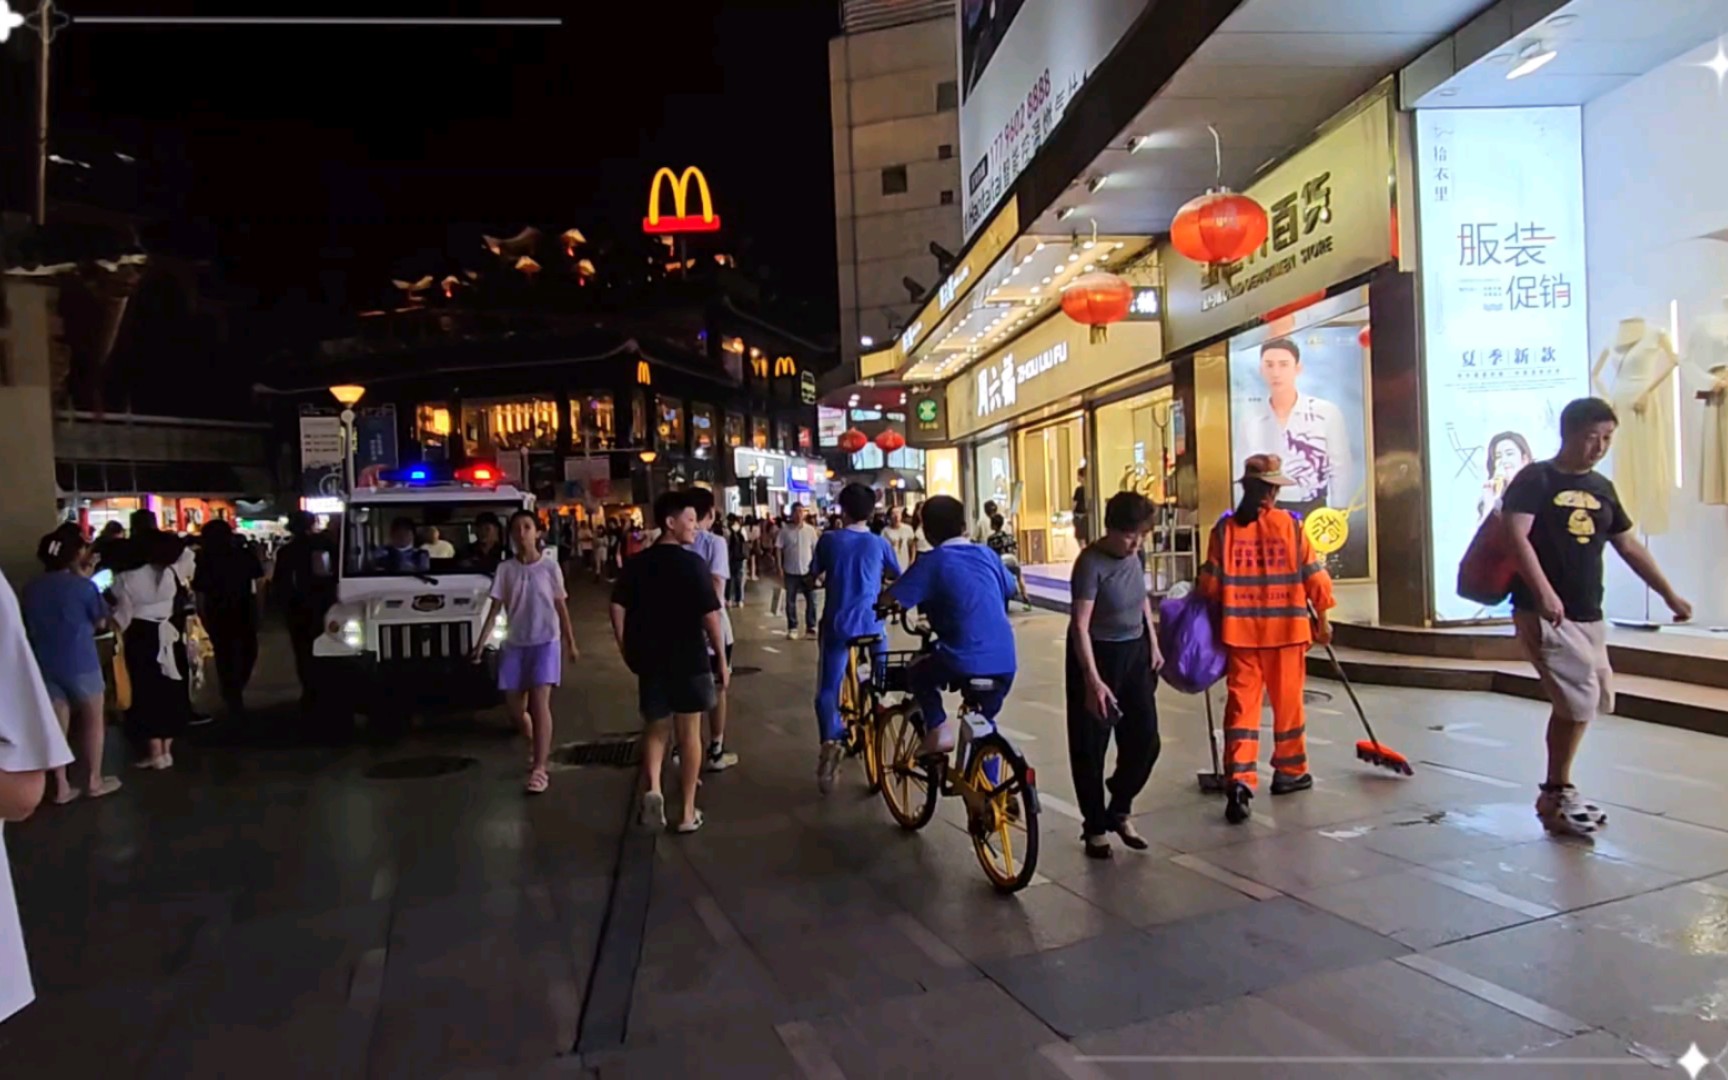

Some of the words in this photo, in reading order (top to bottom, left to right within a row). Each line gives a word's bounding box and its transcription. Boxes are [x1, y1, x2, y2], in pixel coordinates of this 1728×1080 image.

[1300, 235, 1334, 264] STORE
[1457, 221, 1556, 267] 服装
[1506, 273, 1571, 311] 促销
